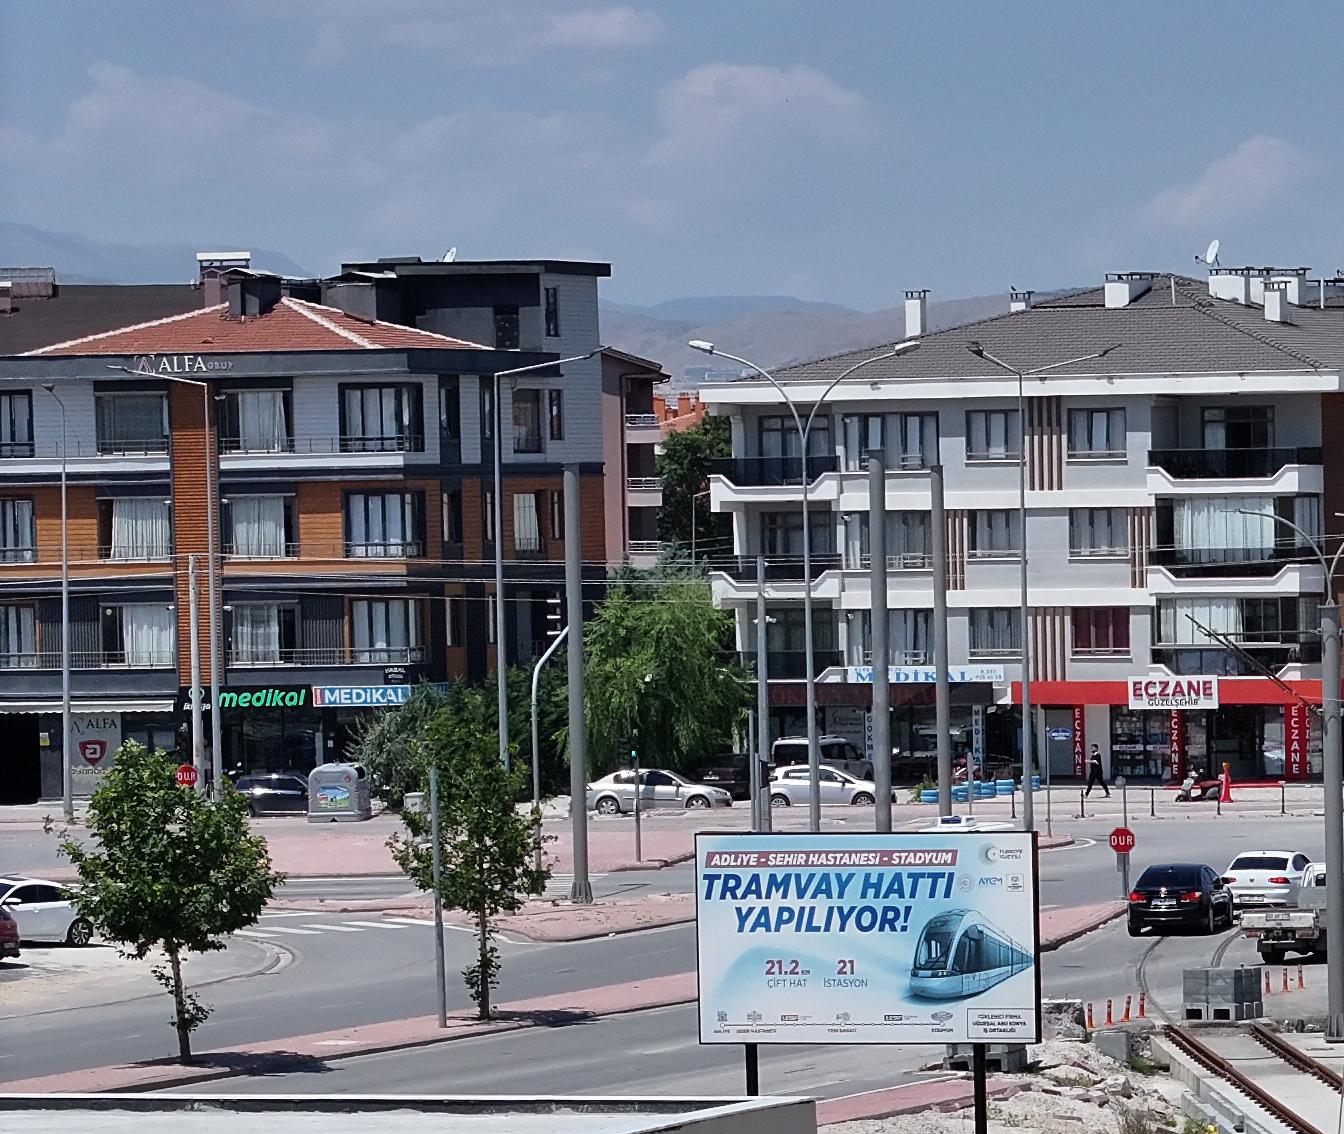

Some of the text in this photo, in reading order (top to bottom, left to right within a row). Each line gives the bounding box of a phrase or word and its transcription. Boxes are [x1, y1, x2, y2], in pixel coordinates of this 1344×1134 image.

[158, 355, 207, 372] ALFA
[1132, 680, 1214, 699] ECZANE
[219, 689, 306, 708] medikal
[86, 717, 117, 729] ALFA
[1074, 708, 1082, 776] ECZANE
[1291, 706, 1300, 774] ECZANE
[177, 772, 196, 781] DUR
[1111, 835, 1134, 846] DUR
[711, 854, 758, 866] ADLİYE
[808, 853, 880, 865] HASTANESİ
[891, 852, 953, 865] STADYUM
[703, 871, 955, 900] TRAMVAY HATTI
[735, 905, 913, 933] YAPILIYOR!
[765, 960, 800, 975] 21.2
[837, 959, 855, 975] 21
[789, 978, 807, 988] HAT
[823, 977, 868, 988] İSTASYON
